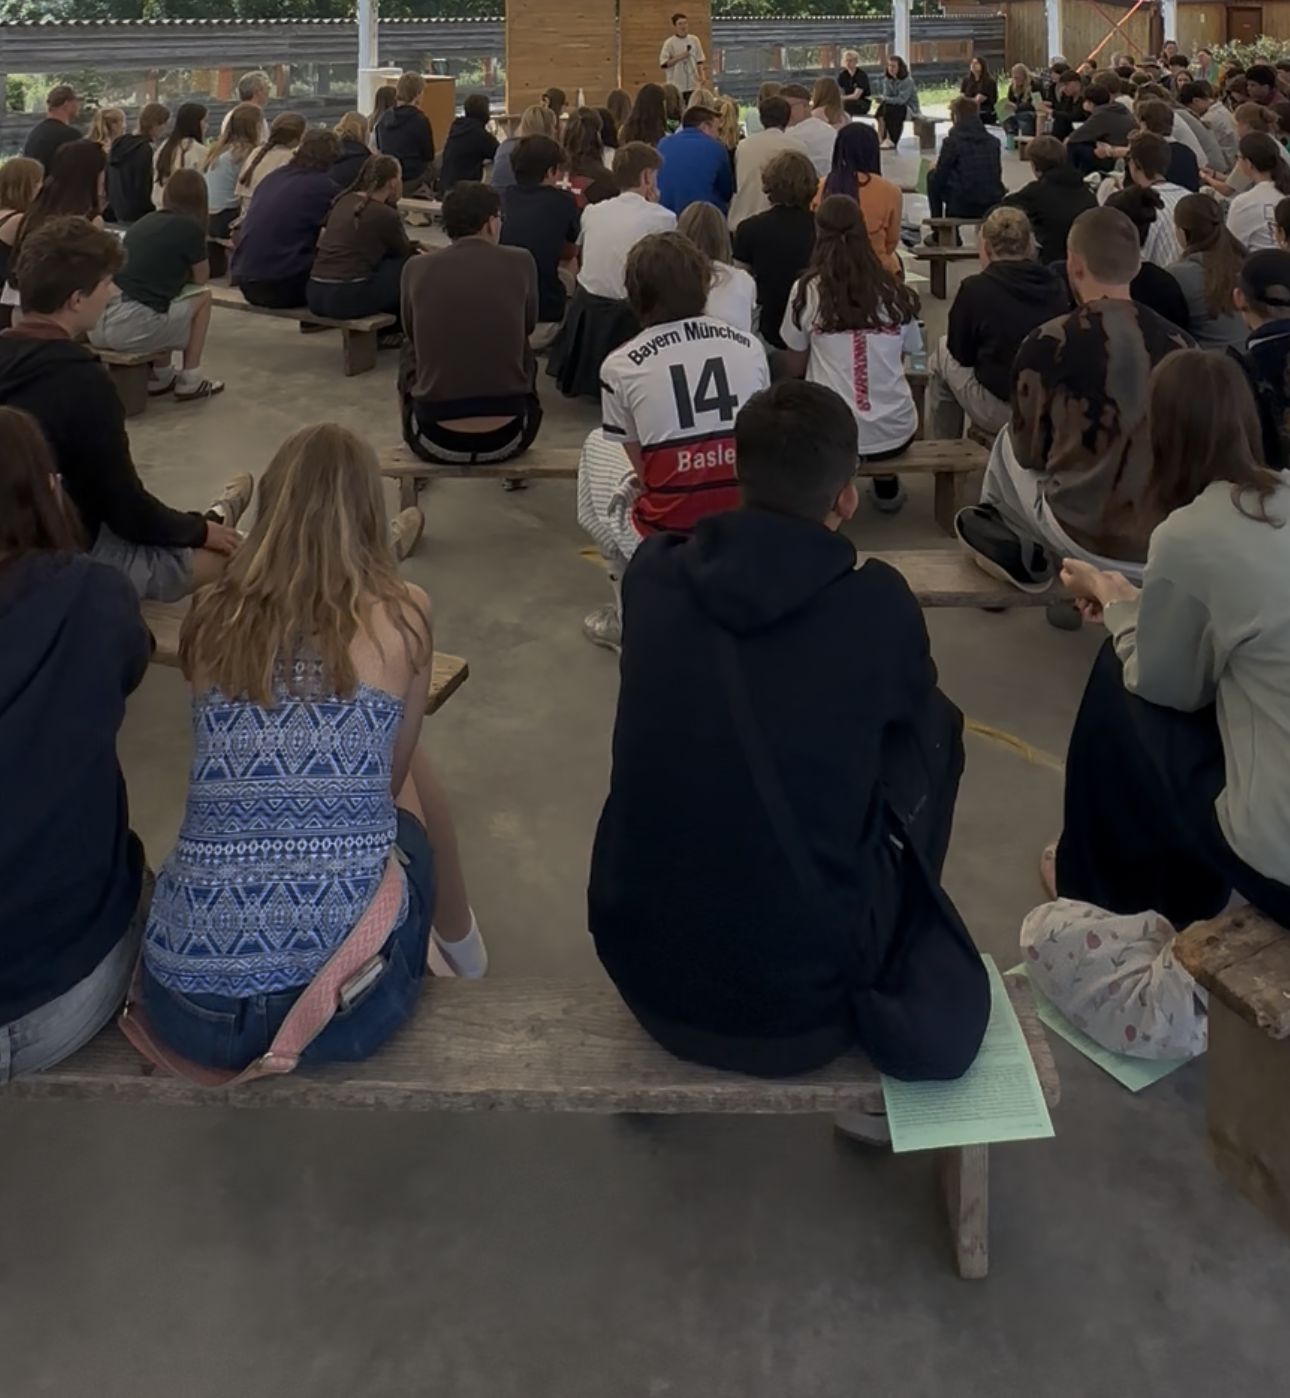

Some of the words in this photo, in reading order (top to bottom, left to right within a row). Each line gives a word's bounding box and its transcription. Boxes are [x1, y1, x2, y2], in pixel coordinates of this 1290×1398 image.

[628, 330, 681, 365] Bayern
[683, 321, 751, 348] München
[669, 356, 739, 429] 14
